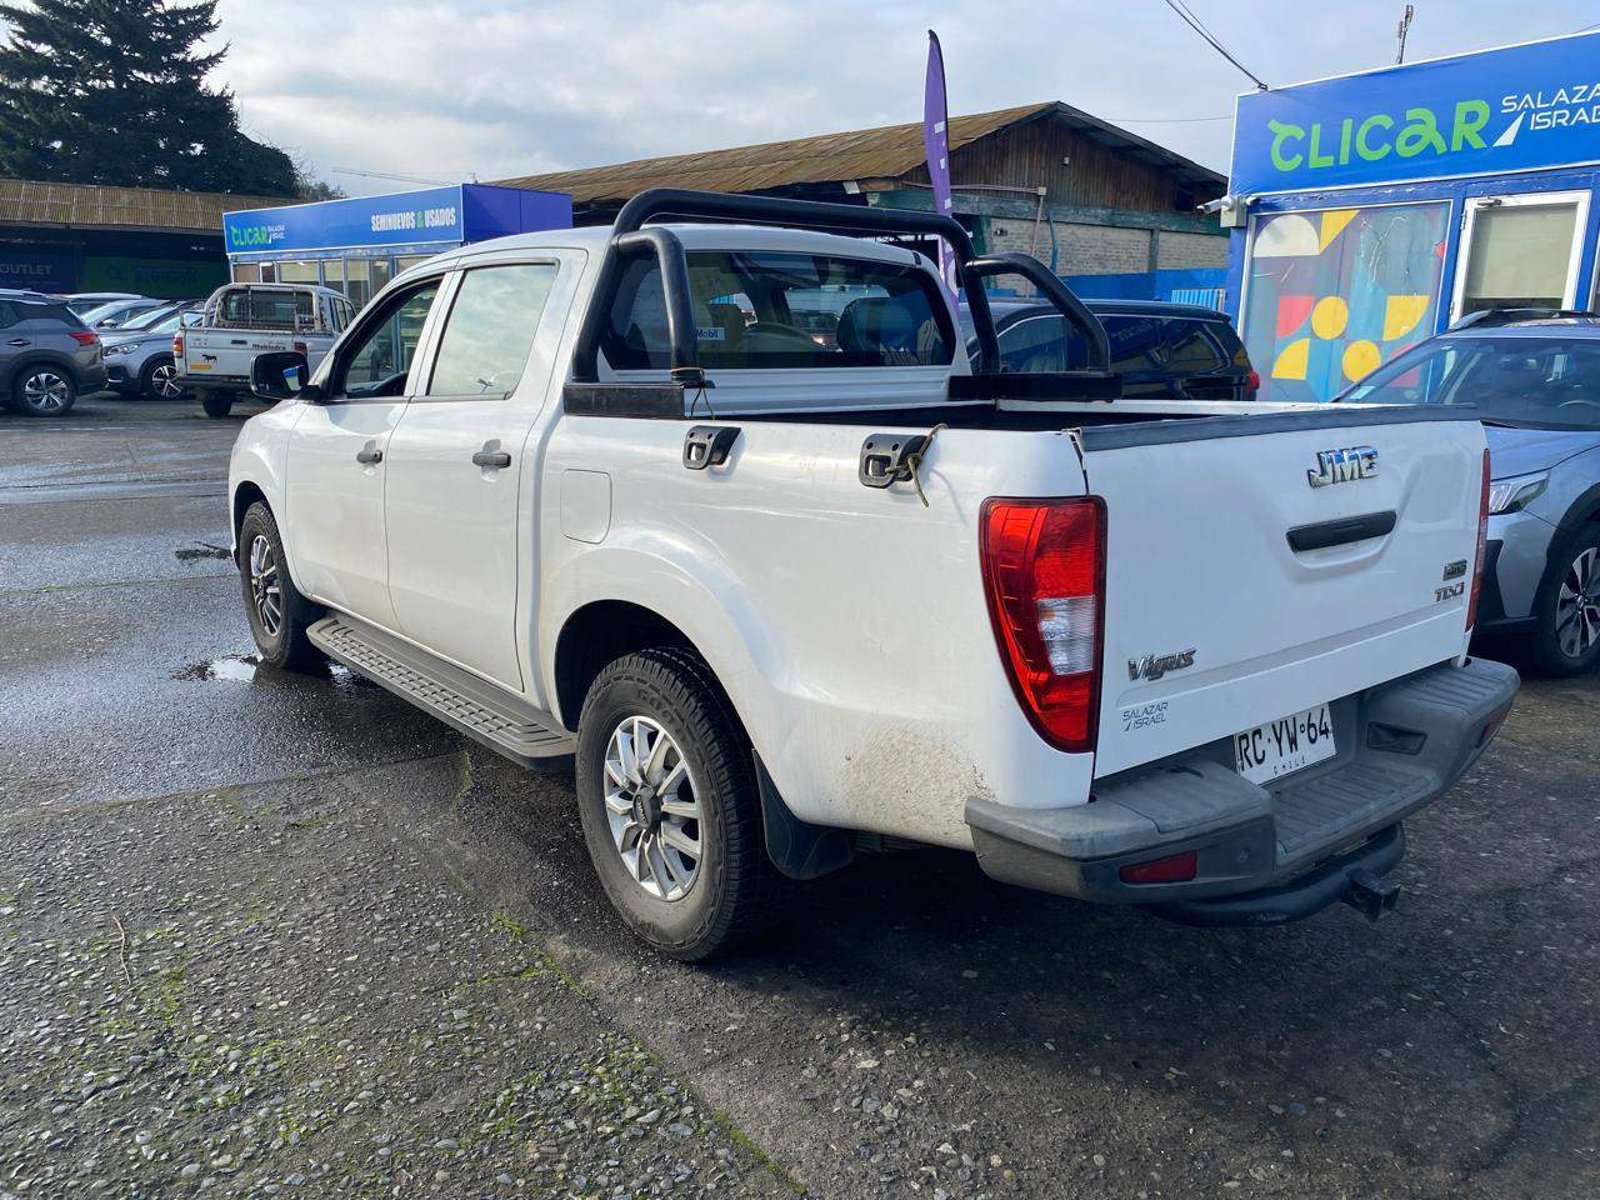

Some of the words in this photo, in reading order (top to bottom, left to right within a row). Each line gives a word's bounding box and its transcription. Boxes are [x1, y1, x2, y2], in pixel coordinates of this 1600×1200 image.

[370, 210, 416, 233] SEMINUEVOS
[424, 207, 456, 229] USADOS
[1128, 648, 1197, 682] Vigus
[1123, 701, 1169, 722] SALAZAR
[1132, 712, 1167, 730] ISRAEL
